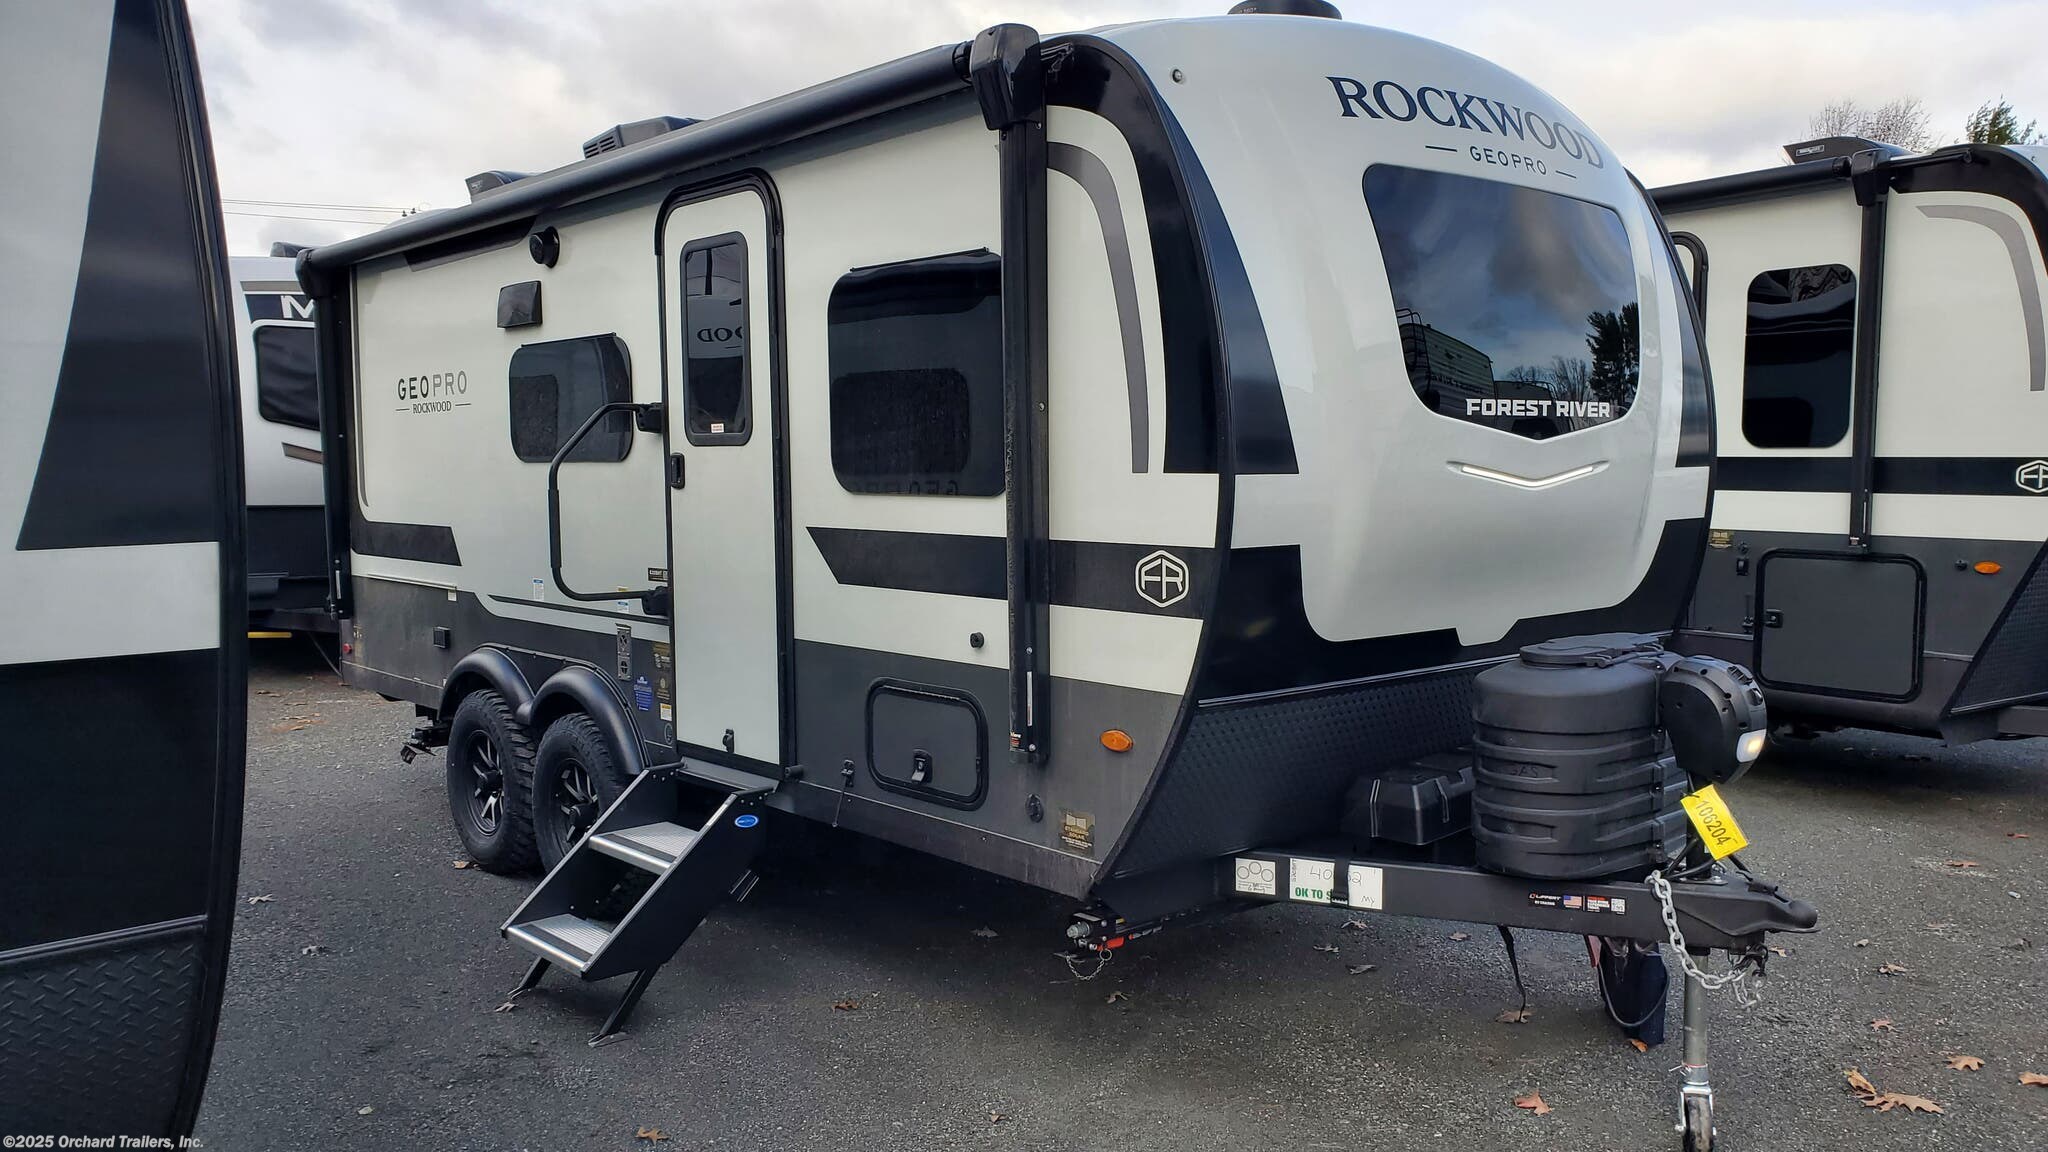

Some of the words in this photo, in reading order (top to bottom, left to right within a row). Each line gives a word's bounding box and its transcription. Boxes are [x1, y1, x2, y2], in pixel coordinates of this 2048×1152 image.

[1326, 76, 1604, 170] ROCKWOOD
[1470, 146, 1547, 175] GEOPRO
[397, 370, 467, 400] GEOPRO
[412, 400, 452, 414] ROCKWOOD
[1466, 399, 1552, 417] FOREST
[1556, 401, 1611, 418] RIVER
[1695, 800, 1731, 846] 106204
[1295, 887, 1309, 898] OK
[1311, 889, 1323, 900] TO
